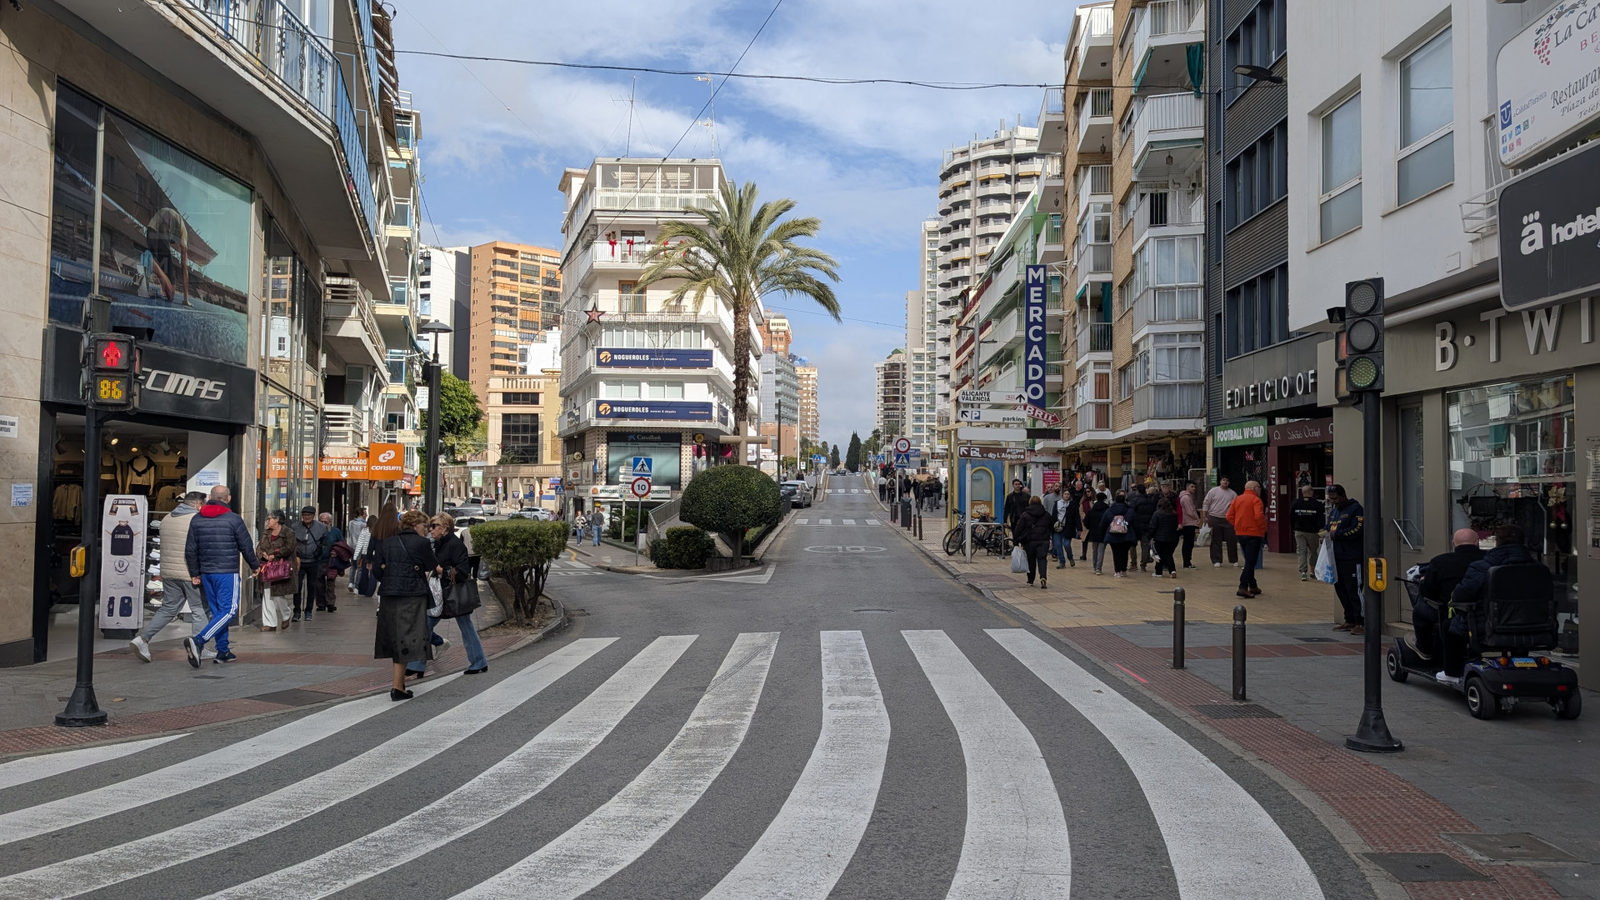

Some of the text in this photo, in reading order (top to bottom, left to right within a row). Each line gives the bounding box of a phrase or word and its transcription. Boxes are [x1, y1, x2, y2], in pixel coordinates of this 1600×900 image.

[1553, 2, 1600, 48] La Ca
[1560, 85, 1600, 118] Plaza de
[1027, 267, 1045, 400] MERCADO
[100, 379, 123, 400] 86
[1226, 375, 1289, 410] EDIFICIO
[1014, 403, 1056, 423] ABRIL
[1217, 430, 1243, 442] FOOTBALL
[321, 464, 368, 472] SUPERMARKET
[322, 457, 368, 466] SUPERMERCADO
